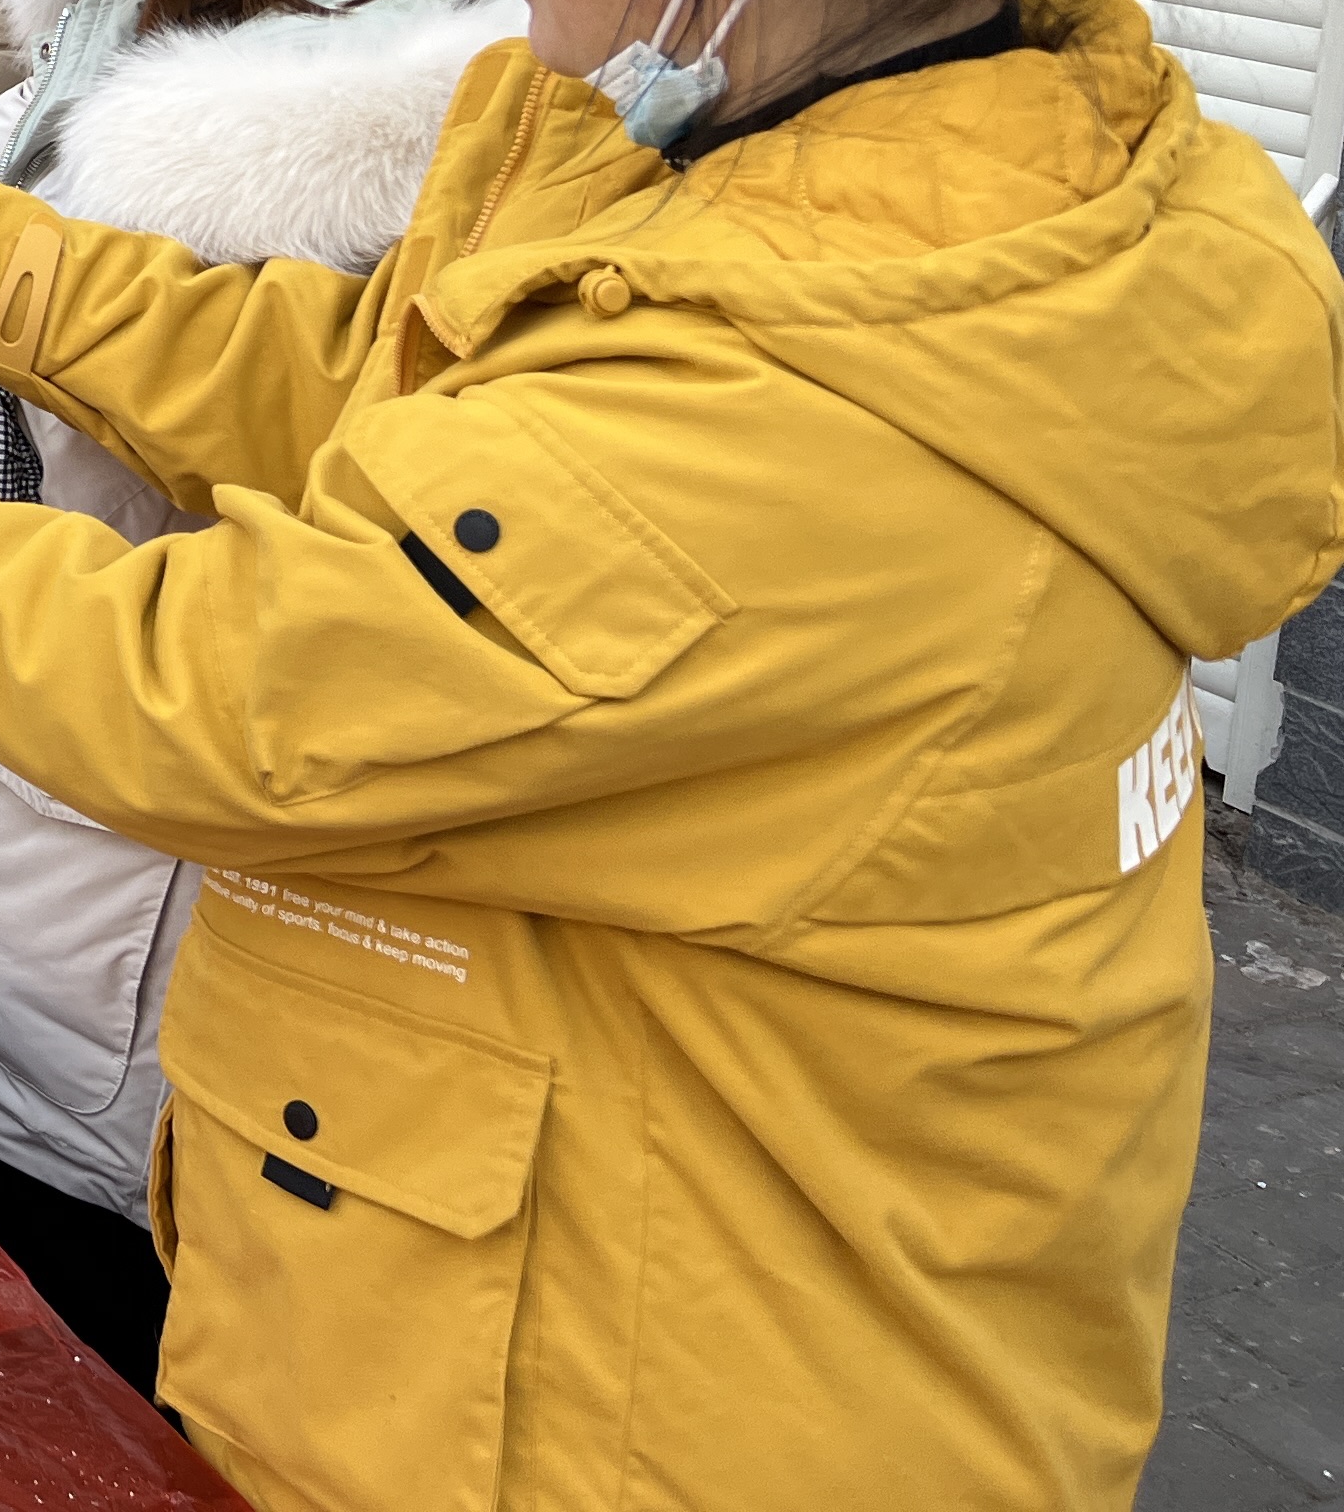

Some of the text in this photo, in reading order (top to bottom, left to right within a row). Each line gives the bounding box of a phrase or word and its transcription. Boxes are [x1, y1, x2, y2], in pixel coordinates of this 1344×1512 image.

[244, 876, 277, 897] 1991
[282, 888, 310, 908] free
[313, 899, 344, 917] your
[345, 909, 375, 930] mind
[377, 918, 387, 934] &
[390, 925, 421, 945] take
[424, 935, 469, 960] action
[261, 903, 276, 917] of
[327, 922, 361, 945] focus
[362, 934, 372, 949] &
[375, 938, 410, 963] keep
[411, 953, 467, 984] moving
